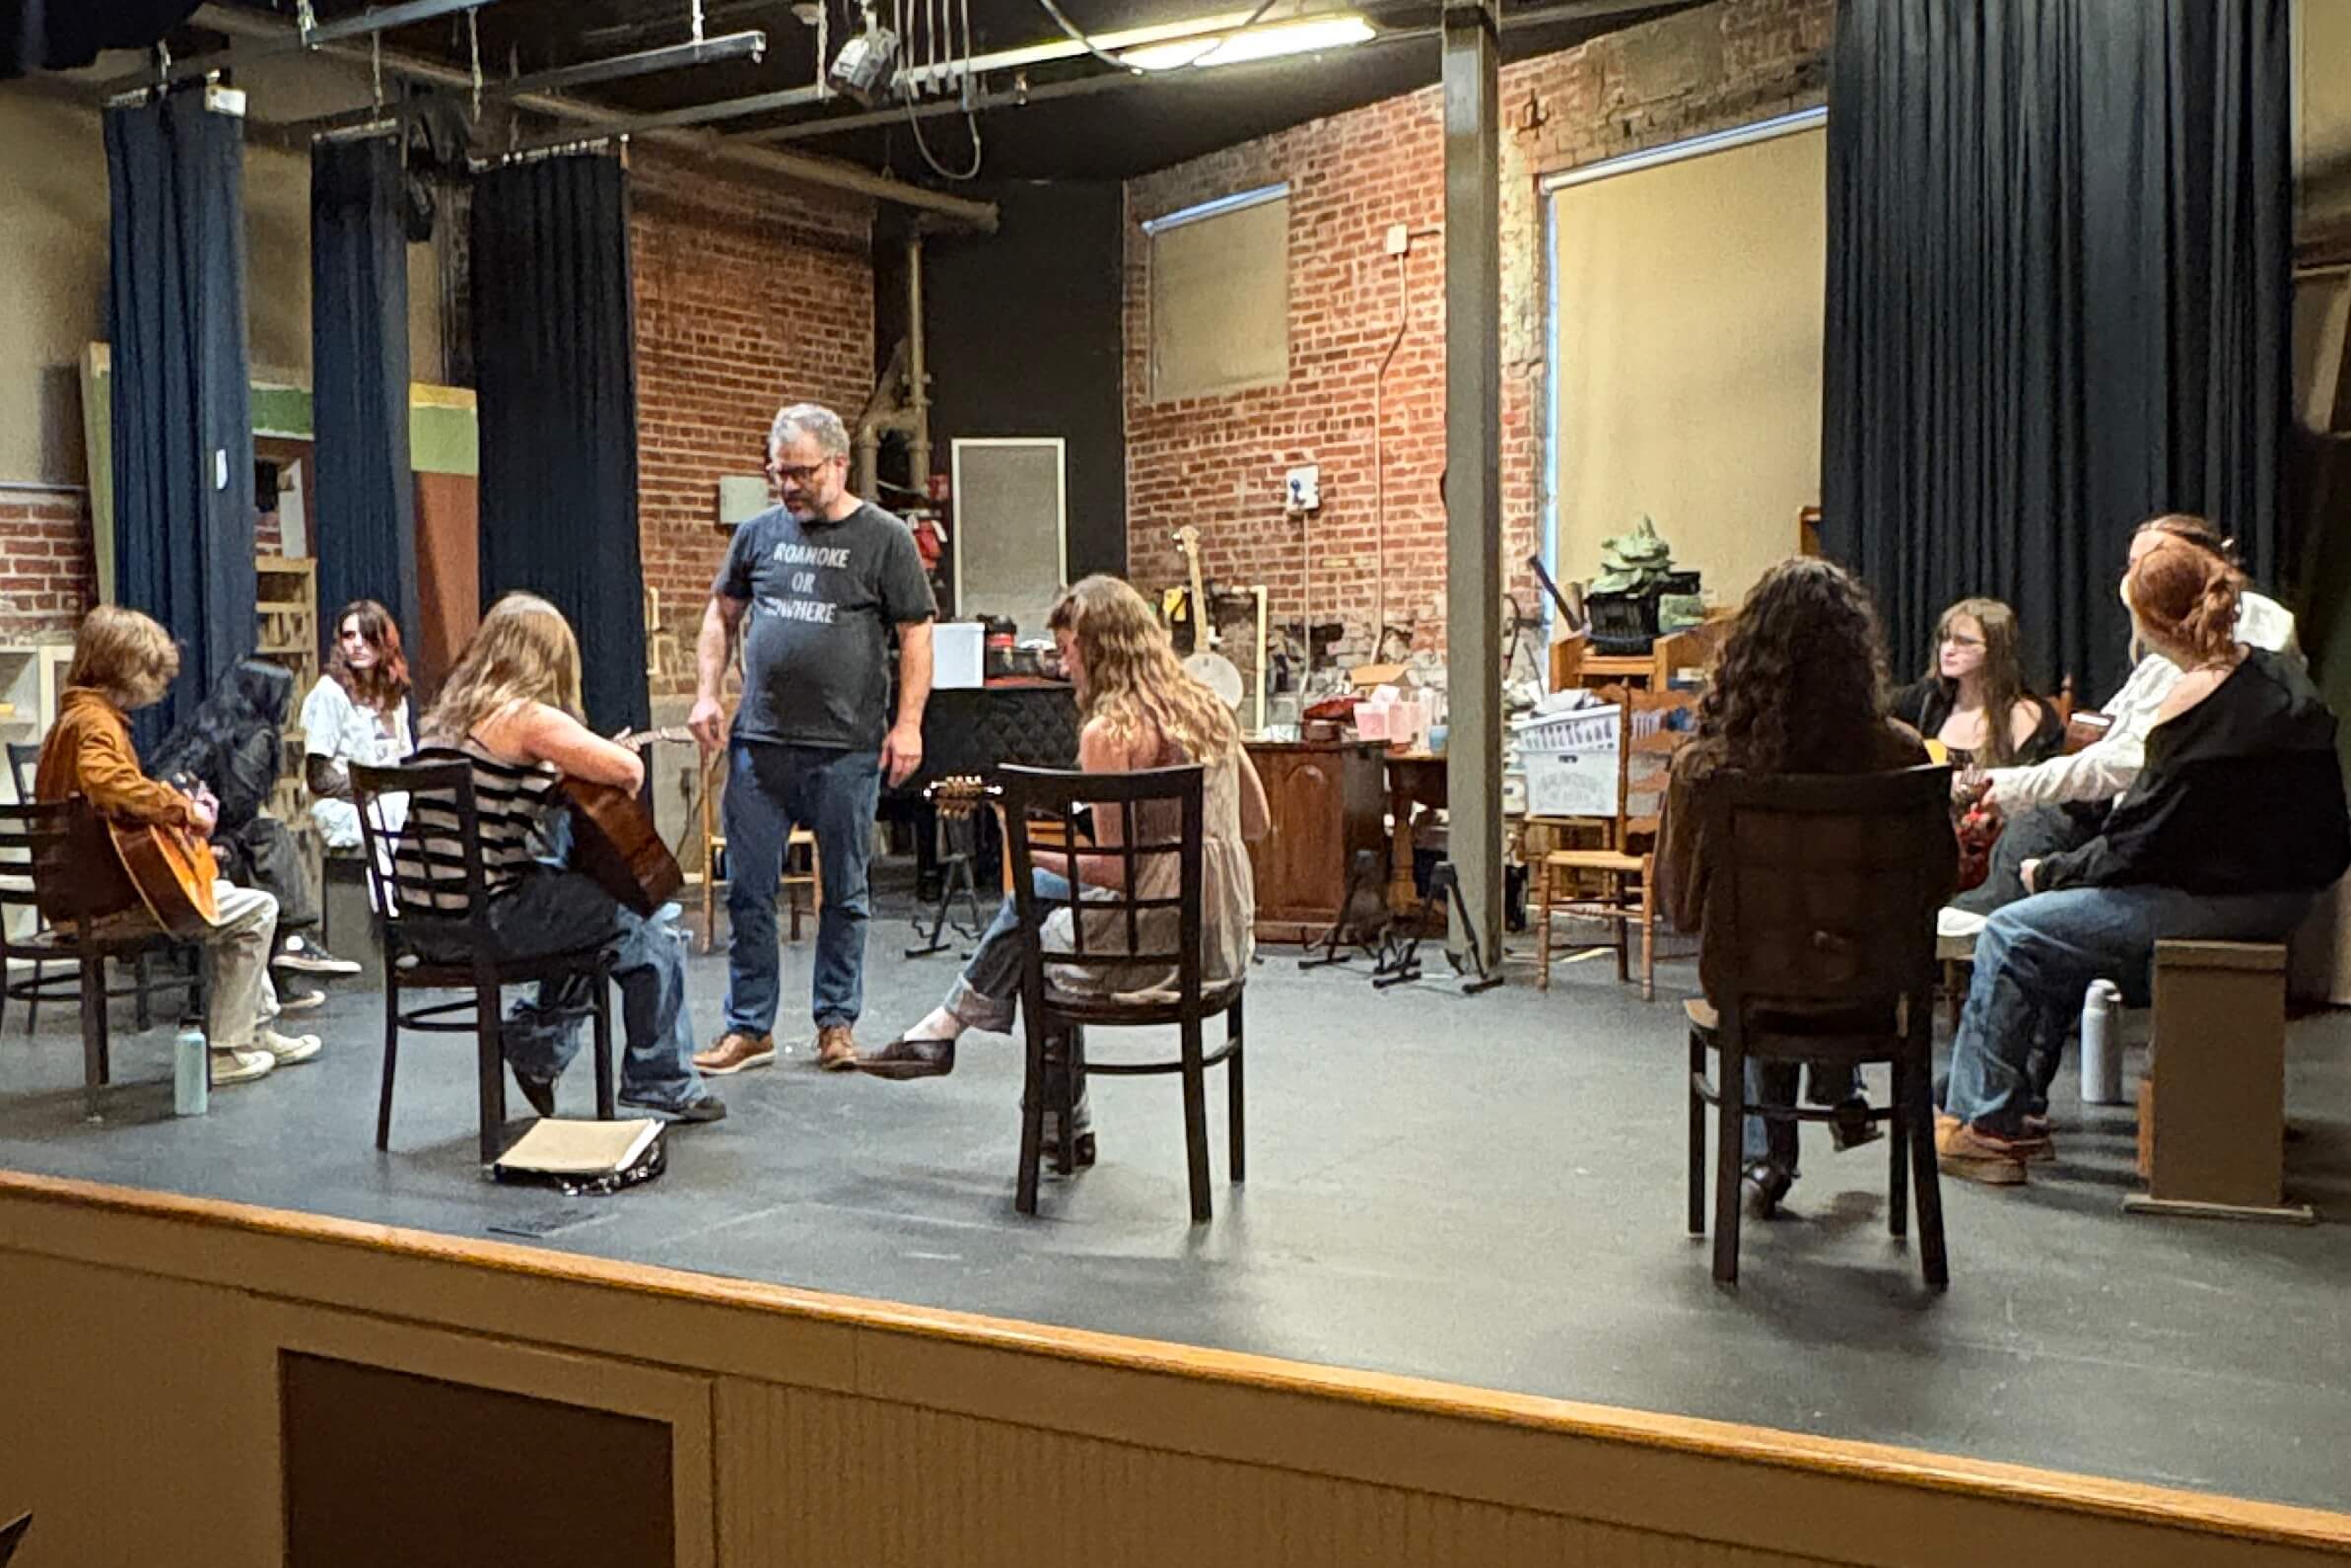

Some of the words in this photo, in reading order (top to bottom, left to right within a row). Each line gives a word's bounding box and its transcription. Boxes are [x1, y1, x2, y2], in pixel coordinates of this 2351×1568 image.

[774, 542, 851, 569] ROANOKE
[792, 571, 816, 593] OR
[764, 597, 837, 624] OWHERE
